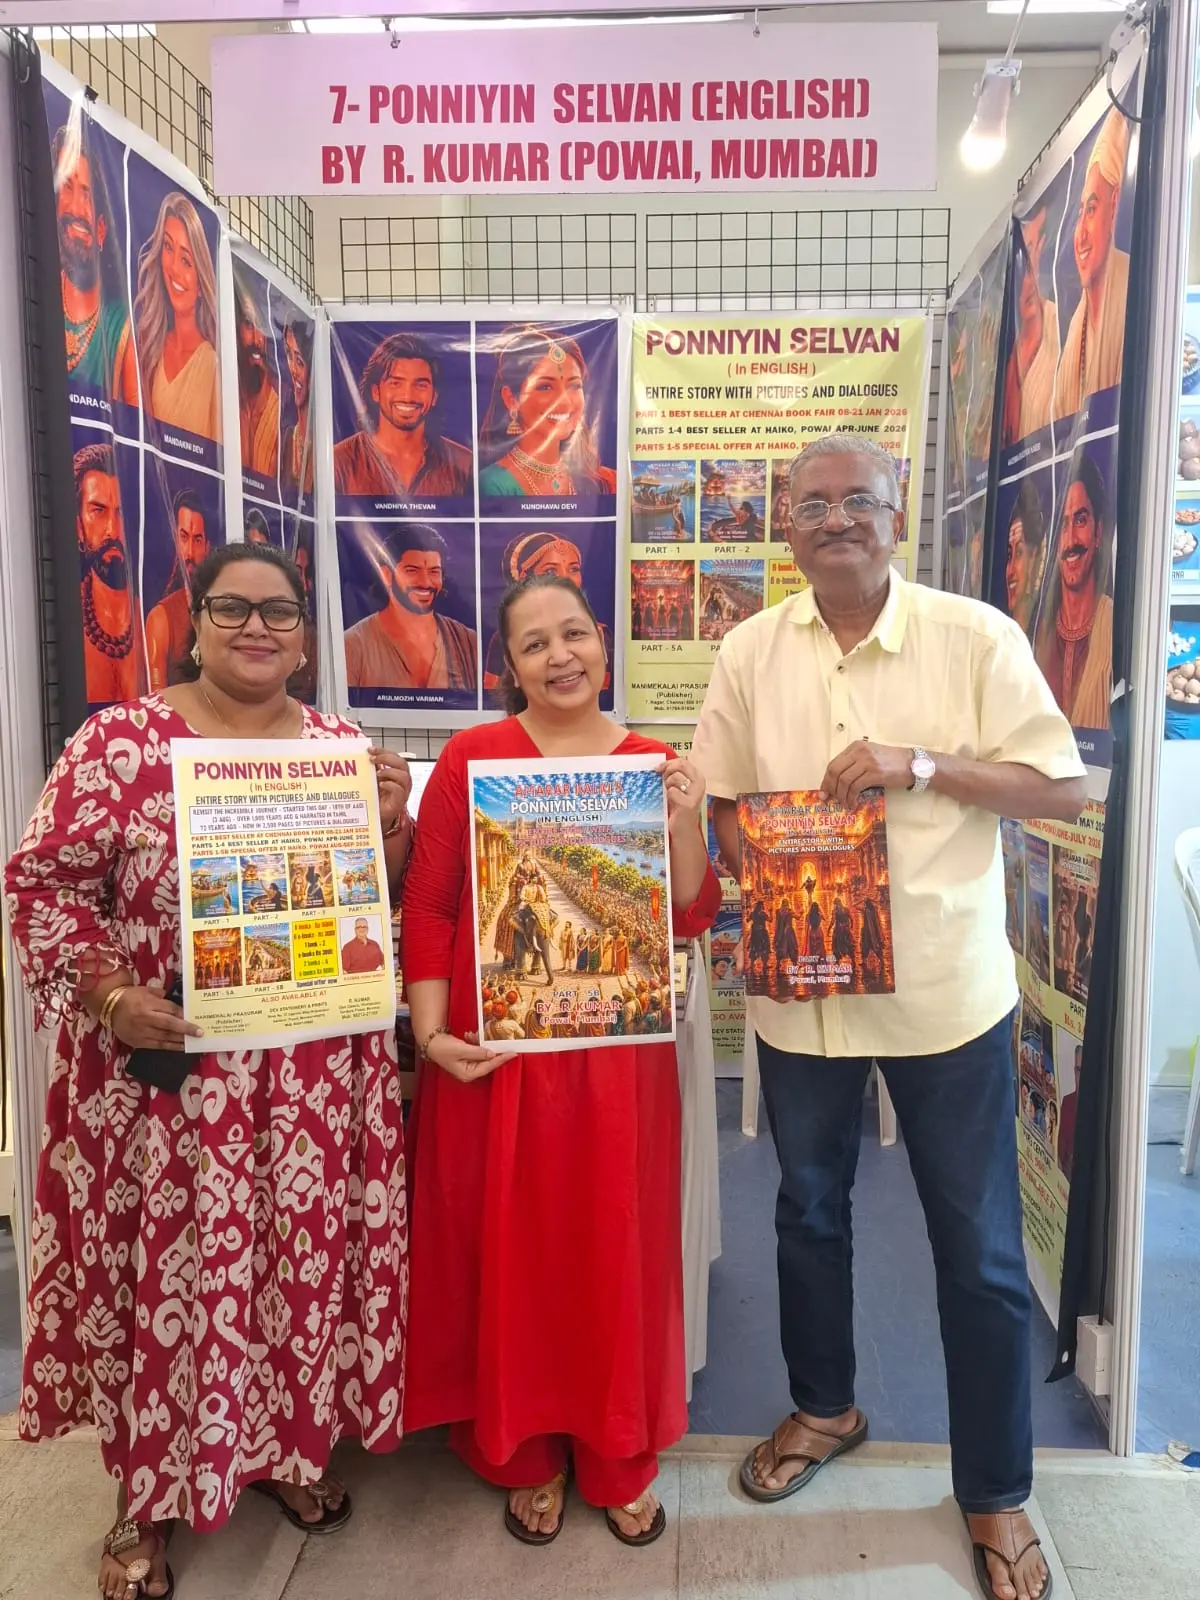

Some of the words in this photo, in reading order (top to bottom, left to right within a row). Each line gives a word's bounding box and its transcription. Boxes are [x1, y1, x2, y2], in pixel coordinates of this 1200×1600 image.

[329, 85, 360, 124] 7-
[369, 84, 535, 124] PONNIYIN
[553, 82, 681, 124] SELVAN
[692, 78, 870, 122] (ENGLISH)
[321, 145, 366, 184] BY
[383, 144, 414, 184] R.
[423, 142, 549, 183] KUMAR
[560, 140, 701, 184] (POWAI,
[711, 138, 878, 179] MUMBAI)
[646, 329, 781, 356] PONNIYIN
[789, 327, 900, 354] SELVAN
[750, 362, 809, 375] ENGLISH
[645, 386, 684, 400] ENTIRE
[687, 386, 722, 399] STORY
[725, 386, 752, 399] WITH
[756, 385, 808, 399] PICTURES
[812, 385, 835, 398] AND
[838, 384, 898, 397] DIALOGUES
[635, 410, 658, 418] PART
[669, 410, 691, 418] BEST
[693, 410, 727, 418] SELLER
[729, 410, 741, 418] AT
[743, 409, 783, 418] CHENNAI
[785, 409, 812, 417] BOOK
[814, 408, 835, 416] FAIR
[865, 408, 882, 416] JAN
[884, 408, 907, 416] 2026
[635, 427, 665, 435] PARTS
[668, 426, 682, 434] 1-4
[686, 426, 709, 434] BEST
[712, 426, 747, 434] SELLER
[750, 426, 761, 434] AT
[765, 426, 797, 435] HAIKO,
[801, 425, 831, 433] POWAI
[835, 425, 880, 433] APR-JUNE
[635, 443, 665, 451] PARTS
[723, 442, 752, 450] OFFER
[754, 442, 765, 450] AT
[767, 442, 799, 450] HAIKO,
[374, 503, 408, 511] VANDHIYA
[409, 503, 437, 511] THEVAN
[521, 503, 560, 511] KUNDHAVAI
[561, 503, 578, 511] DEVI
[416, 695, 444, 703] VARMAN
[193, 761, 281, 779] PONNIYIN
[287, 760, 358, 778] SELVAN
[264, 782, 302, 791] ENGLISH
[515, 784, 570, 798] AMARAR
[195, 796, 222, 805] ENTIRE
[224, 795, 247, 804] STORY
[249, 795, 267, 803] WITH
[269, 793, 304, 803] PICTURES
[306, 793, 320, 801] AND
[322, 791, 360, 801] DIALOGUES
[511, 800, 576, 814] PONNIYIN
[579, 798, 628, 812] SELVAN
[554, 814, 603, 823] ENGLISH)
[765, 818, 816, 829] PONNIYIN
[818, 814, 857, 827] SELVAN
[768, 846, 799, 854] PICTURES
[800, 845, 816, 853] AND
[817, 844, 855, 852] DIALOGUES
[536, 1003, 552, 1013] BY
[576, 1001, 621, 1012] KUMAR
[1070, 1001, 1085, 1017] PART
